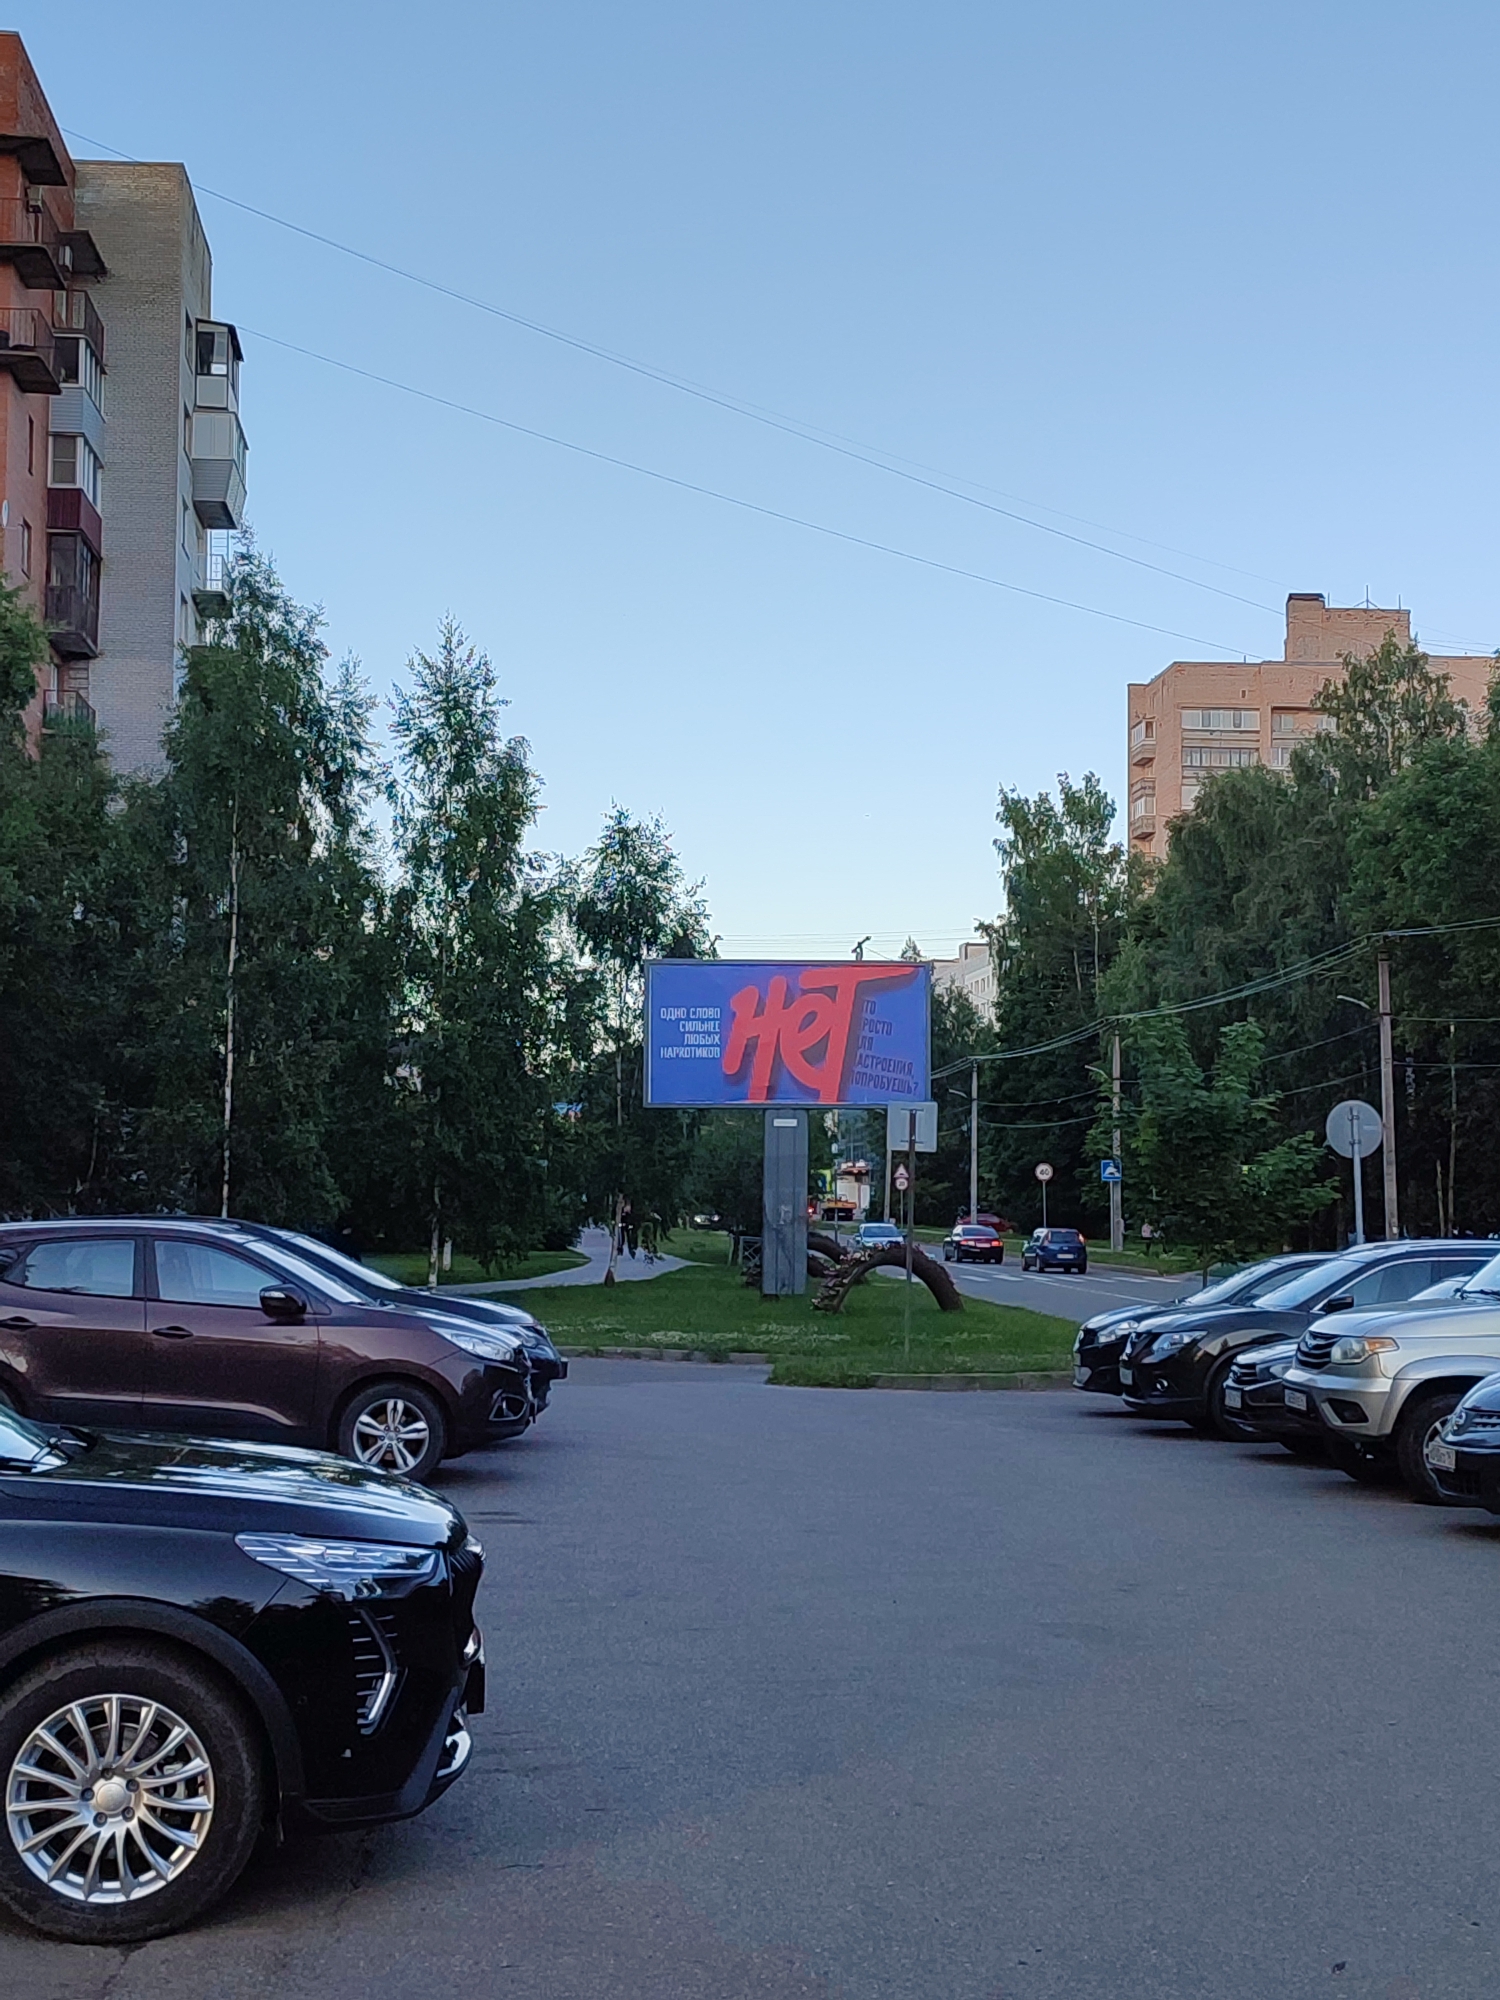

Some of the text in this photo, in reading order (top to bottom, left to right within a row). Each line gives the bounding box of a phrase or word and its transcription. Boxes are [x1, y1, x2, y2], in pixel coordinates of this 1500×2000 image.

[660, 1007, 721, 1021] ОДНО СЛОВО
[862, 1000, 876, 1015] ТО
[679, 1020, 720, 1032] СИЛЬНЕЕ
[861, 1018, 893, 1036] РОСТО
[684, 1033, 721, 1046] ЛЮБЫХ
[858, 1035, 874, 1051] ЛЯ
[660, 1046, 720, 1059] НАРКОТИКОВ
[857, 1052, 915, 1079] АСТРОЕНИЯ,
[1039, 1168, 1050, 1176] 40
